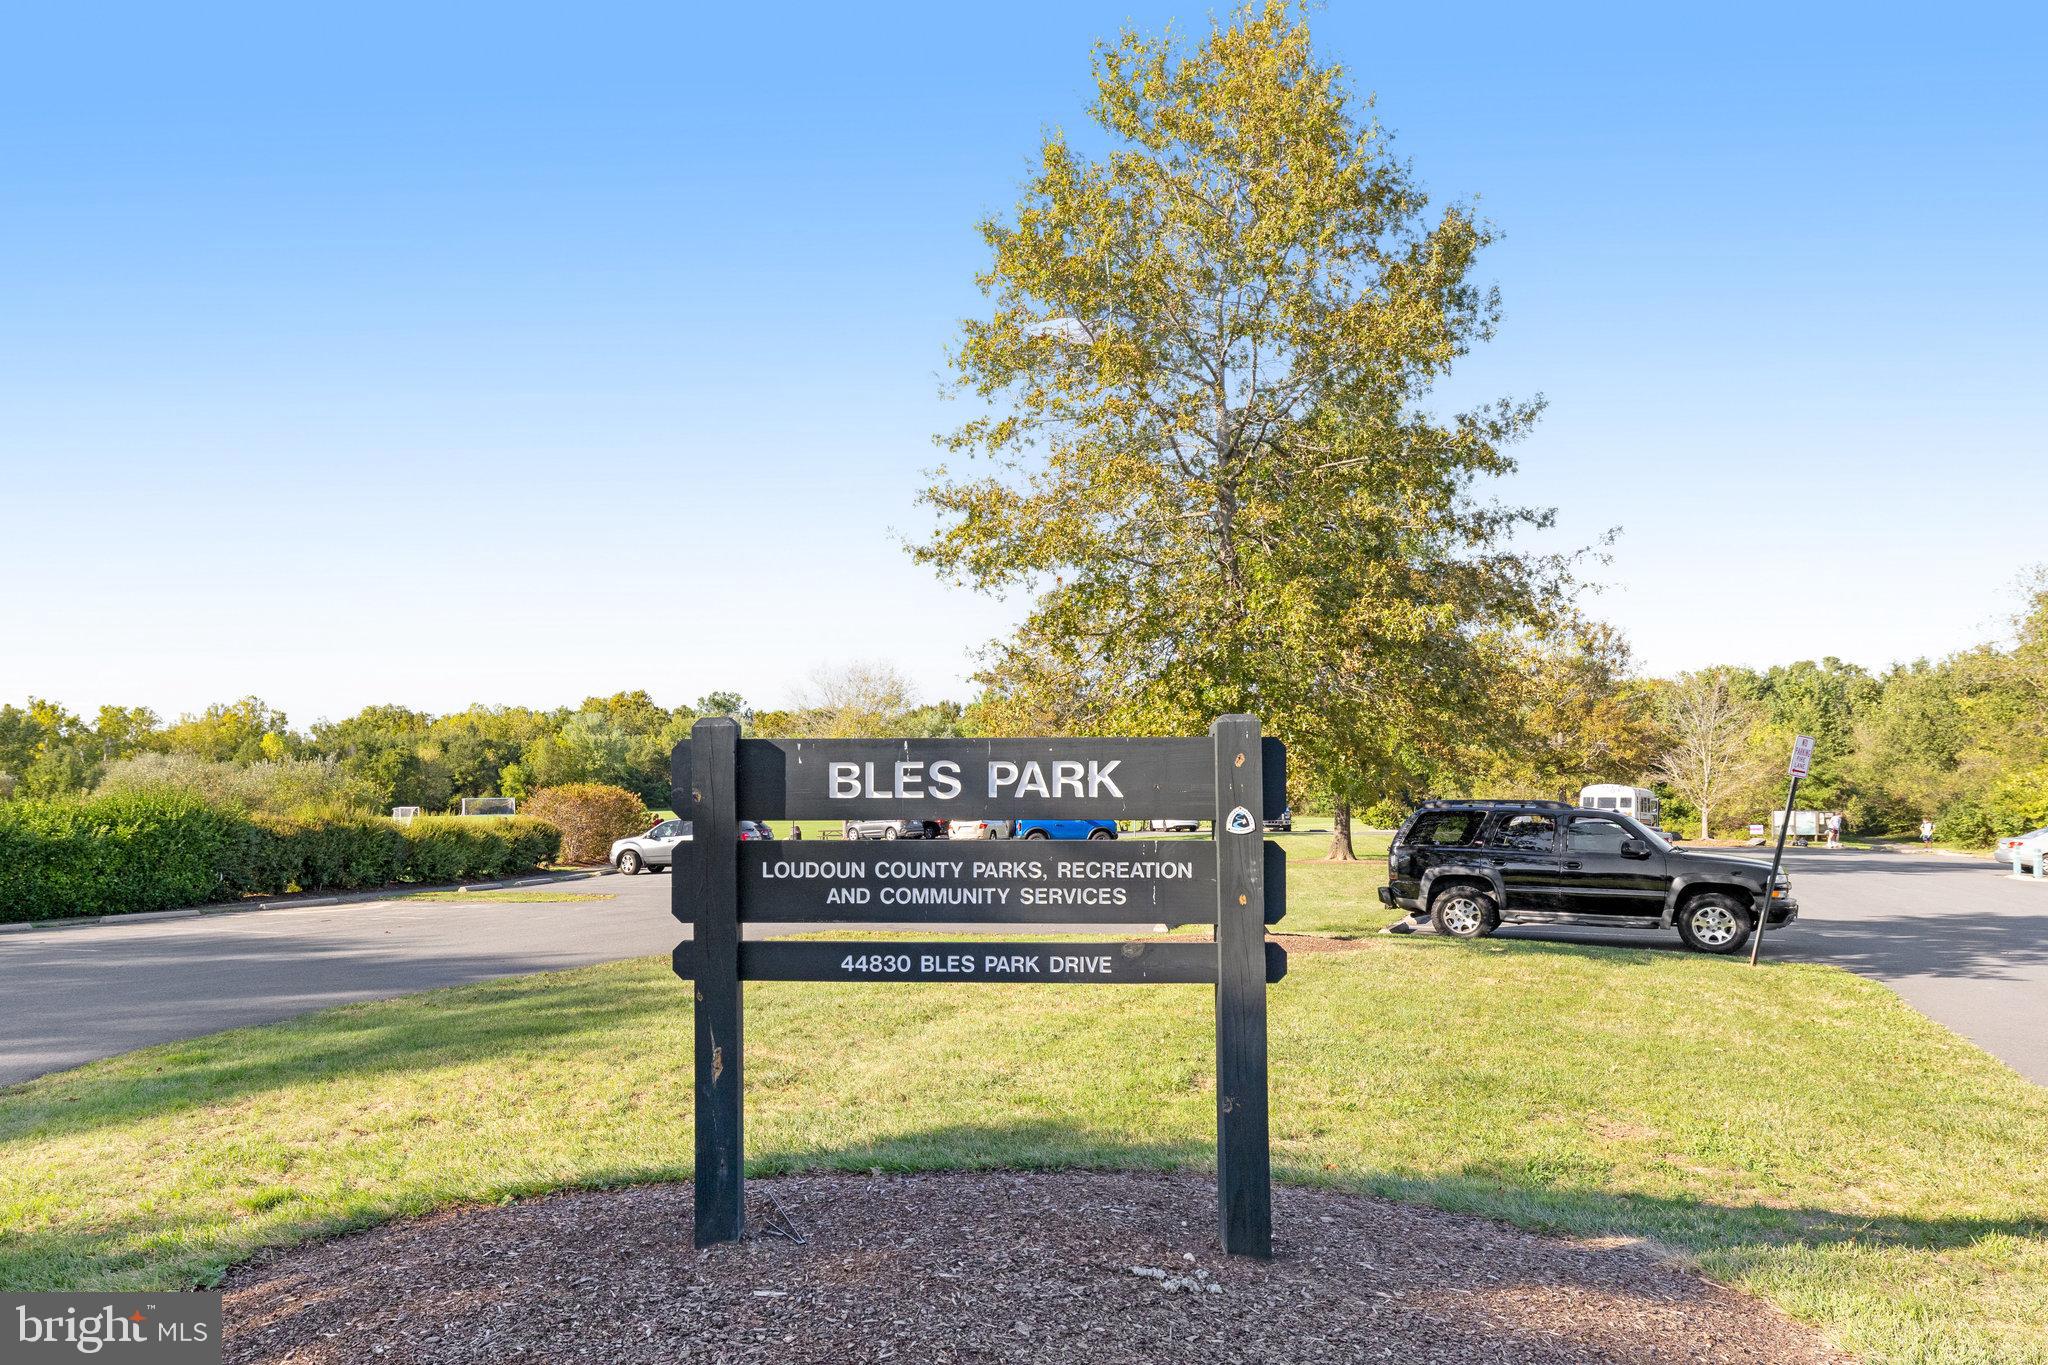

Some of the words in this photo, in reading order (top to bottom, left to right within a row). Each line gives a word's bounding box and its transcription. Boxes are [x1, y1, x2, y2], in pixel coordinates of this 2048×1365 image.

[828, 760, 962, 799] BLES
[988, 760, 1125, 799] PARK
[762, 861, 866, 879] LOUDOUN
[875, 861, 963, 879] COUNTY
[973, 861, 1047, 881] PARKS,
[1058, 861, 1193, 879] RECREATION
[826, 887, 871, 905] AND
[879, 887, 1010, 905] COMMUNITY
[1020, 887, 1127, 905] SERVICES
[841, 954, 911, 973] 44830
[920, 954, 974, 973] BLES
[985, 955, 1040, 973] PARK
[1050, 955, 1113, 974] DRIVE
